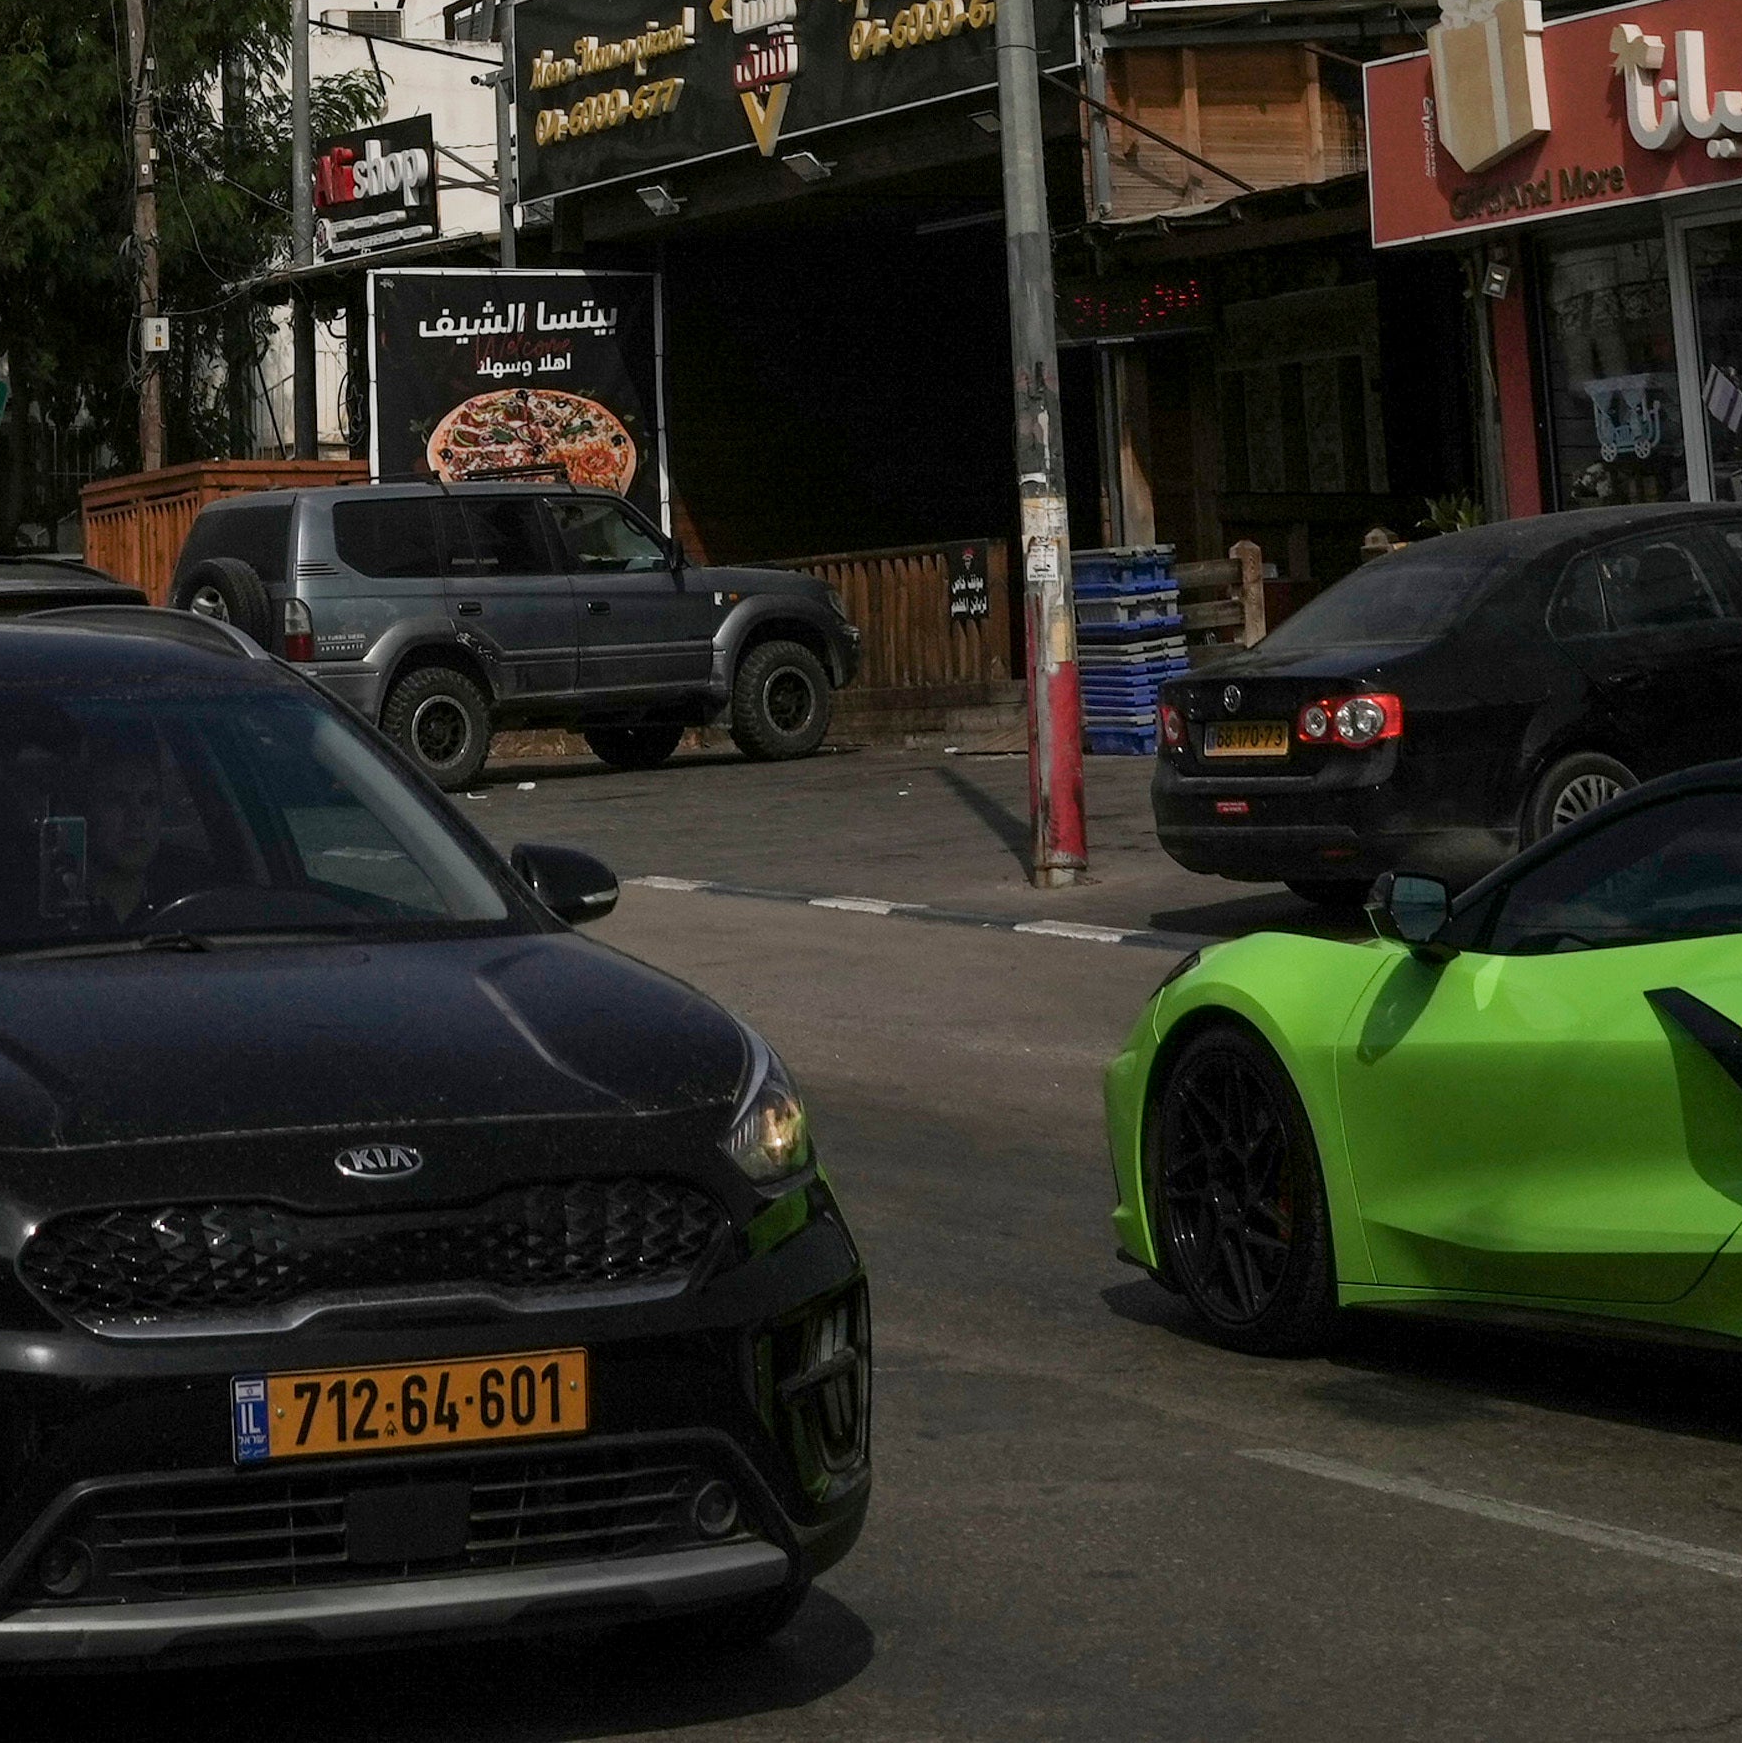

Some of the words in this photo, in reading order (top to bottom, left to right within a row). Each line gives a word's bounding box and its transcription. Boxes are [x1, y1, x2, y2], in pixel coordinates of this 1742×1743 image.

[536, 78, 685, 146] 04-6000-677
[1559, 164, 1626, 203] More
[418, 300, 526, 344] الشيف
[536, 299, 618, 336] بيتسا
[349, 1146, 414, 1171] KIA
[240, 1403, 261, 1433] IL
